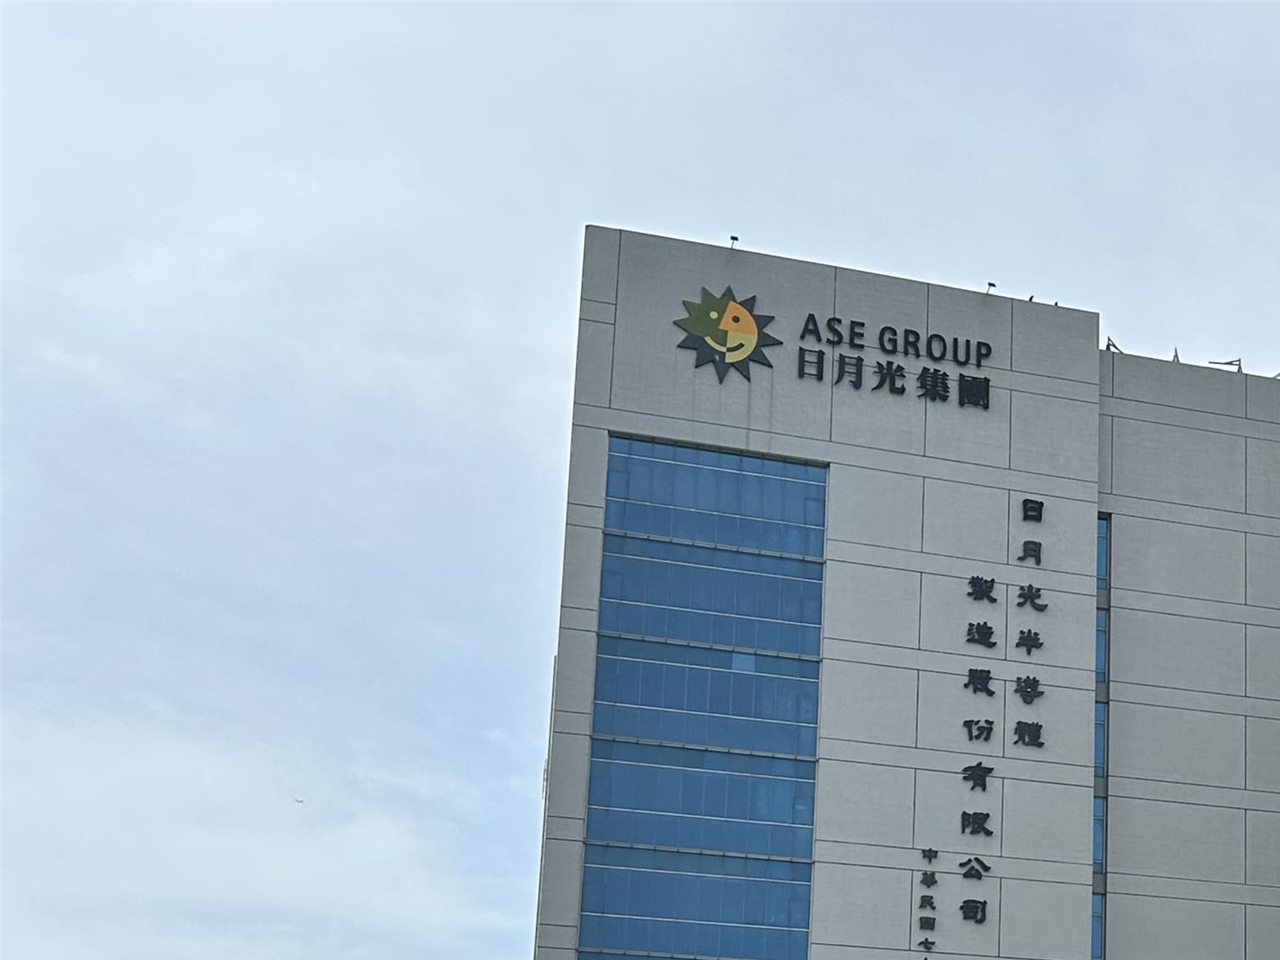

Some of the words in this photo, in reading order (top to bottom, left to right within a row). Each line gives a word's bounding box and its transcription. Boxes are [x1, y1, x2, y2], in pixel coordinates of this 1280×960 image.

[800, 313, 866, 349] ASE
[878, 325, 992, 368] GROUP
[798, 347, 991, 410] 日月光集團
